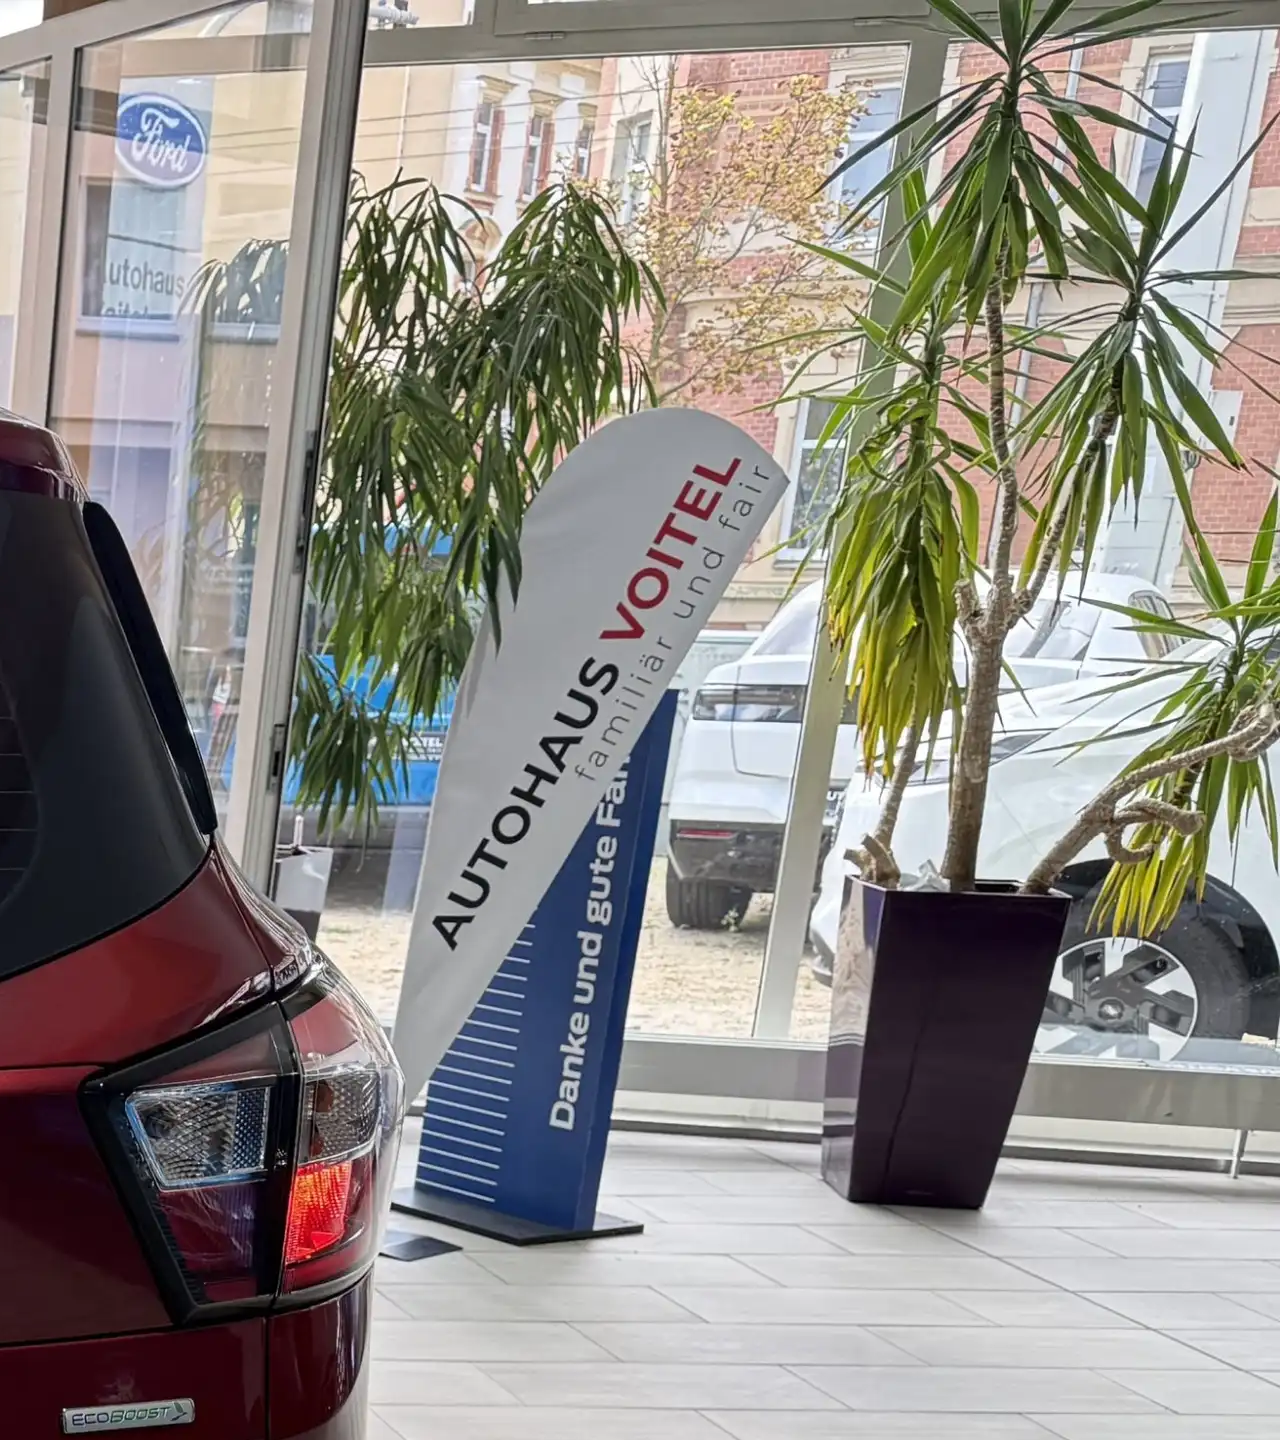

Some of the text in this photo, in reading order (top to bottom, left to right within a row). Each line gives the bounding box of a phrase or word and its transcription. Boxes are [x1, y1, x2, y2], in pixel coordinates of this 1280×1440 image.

[107, 258, 186, 299] utohaus
[131, 107, 192, 174] Ford
[431, 457, 742, 951] AUTOHAUS VOITEL
[575, 464, 772, 781] familiär und fair
[549, 754, 632, 1132] Danke und gute Fa
